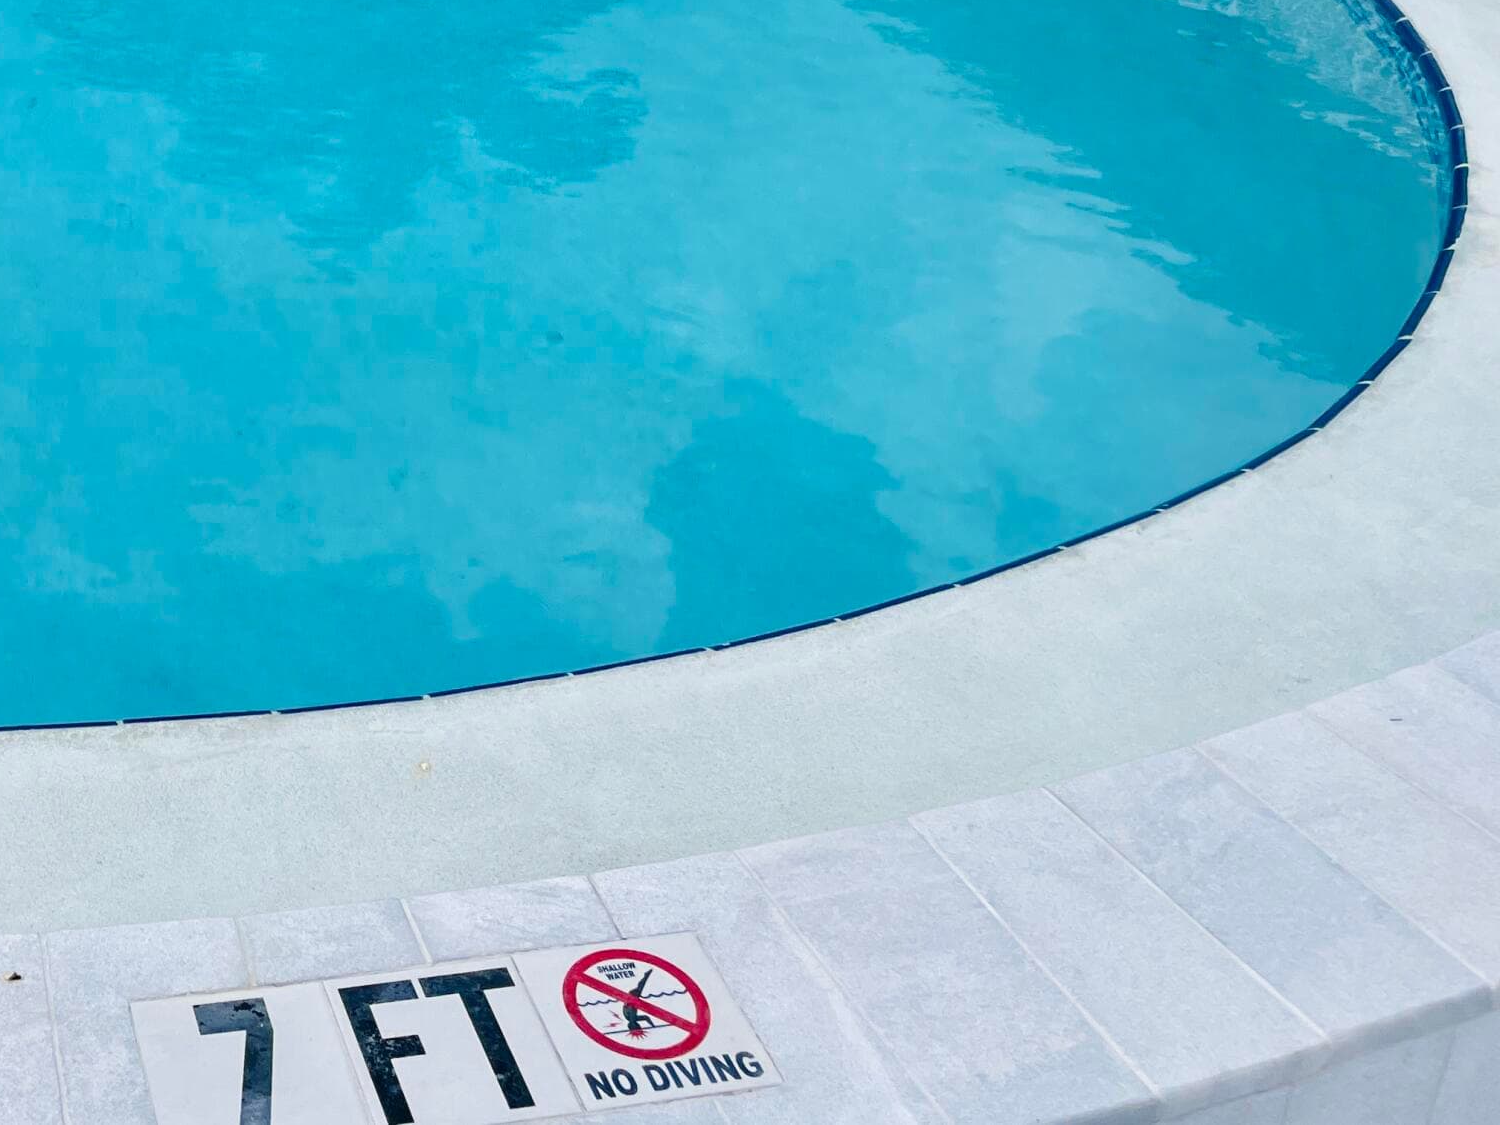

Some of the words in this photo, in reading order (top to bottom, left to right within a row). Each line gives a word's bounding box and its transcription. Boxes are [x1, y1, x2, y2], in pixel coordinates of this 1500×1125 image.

[597, 962, 636, 973] SHALLOW
[606, 970, 635, 981] WATER
[192, 997, 274, 1125] 7
[338, 967, 536, 1125] FT
[584, 1068, 639, 1100] NO
[643, 1051, 765, 1091] DIVING
